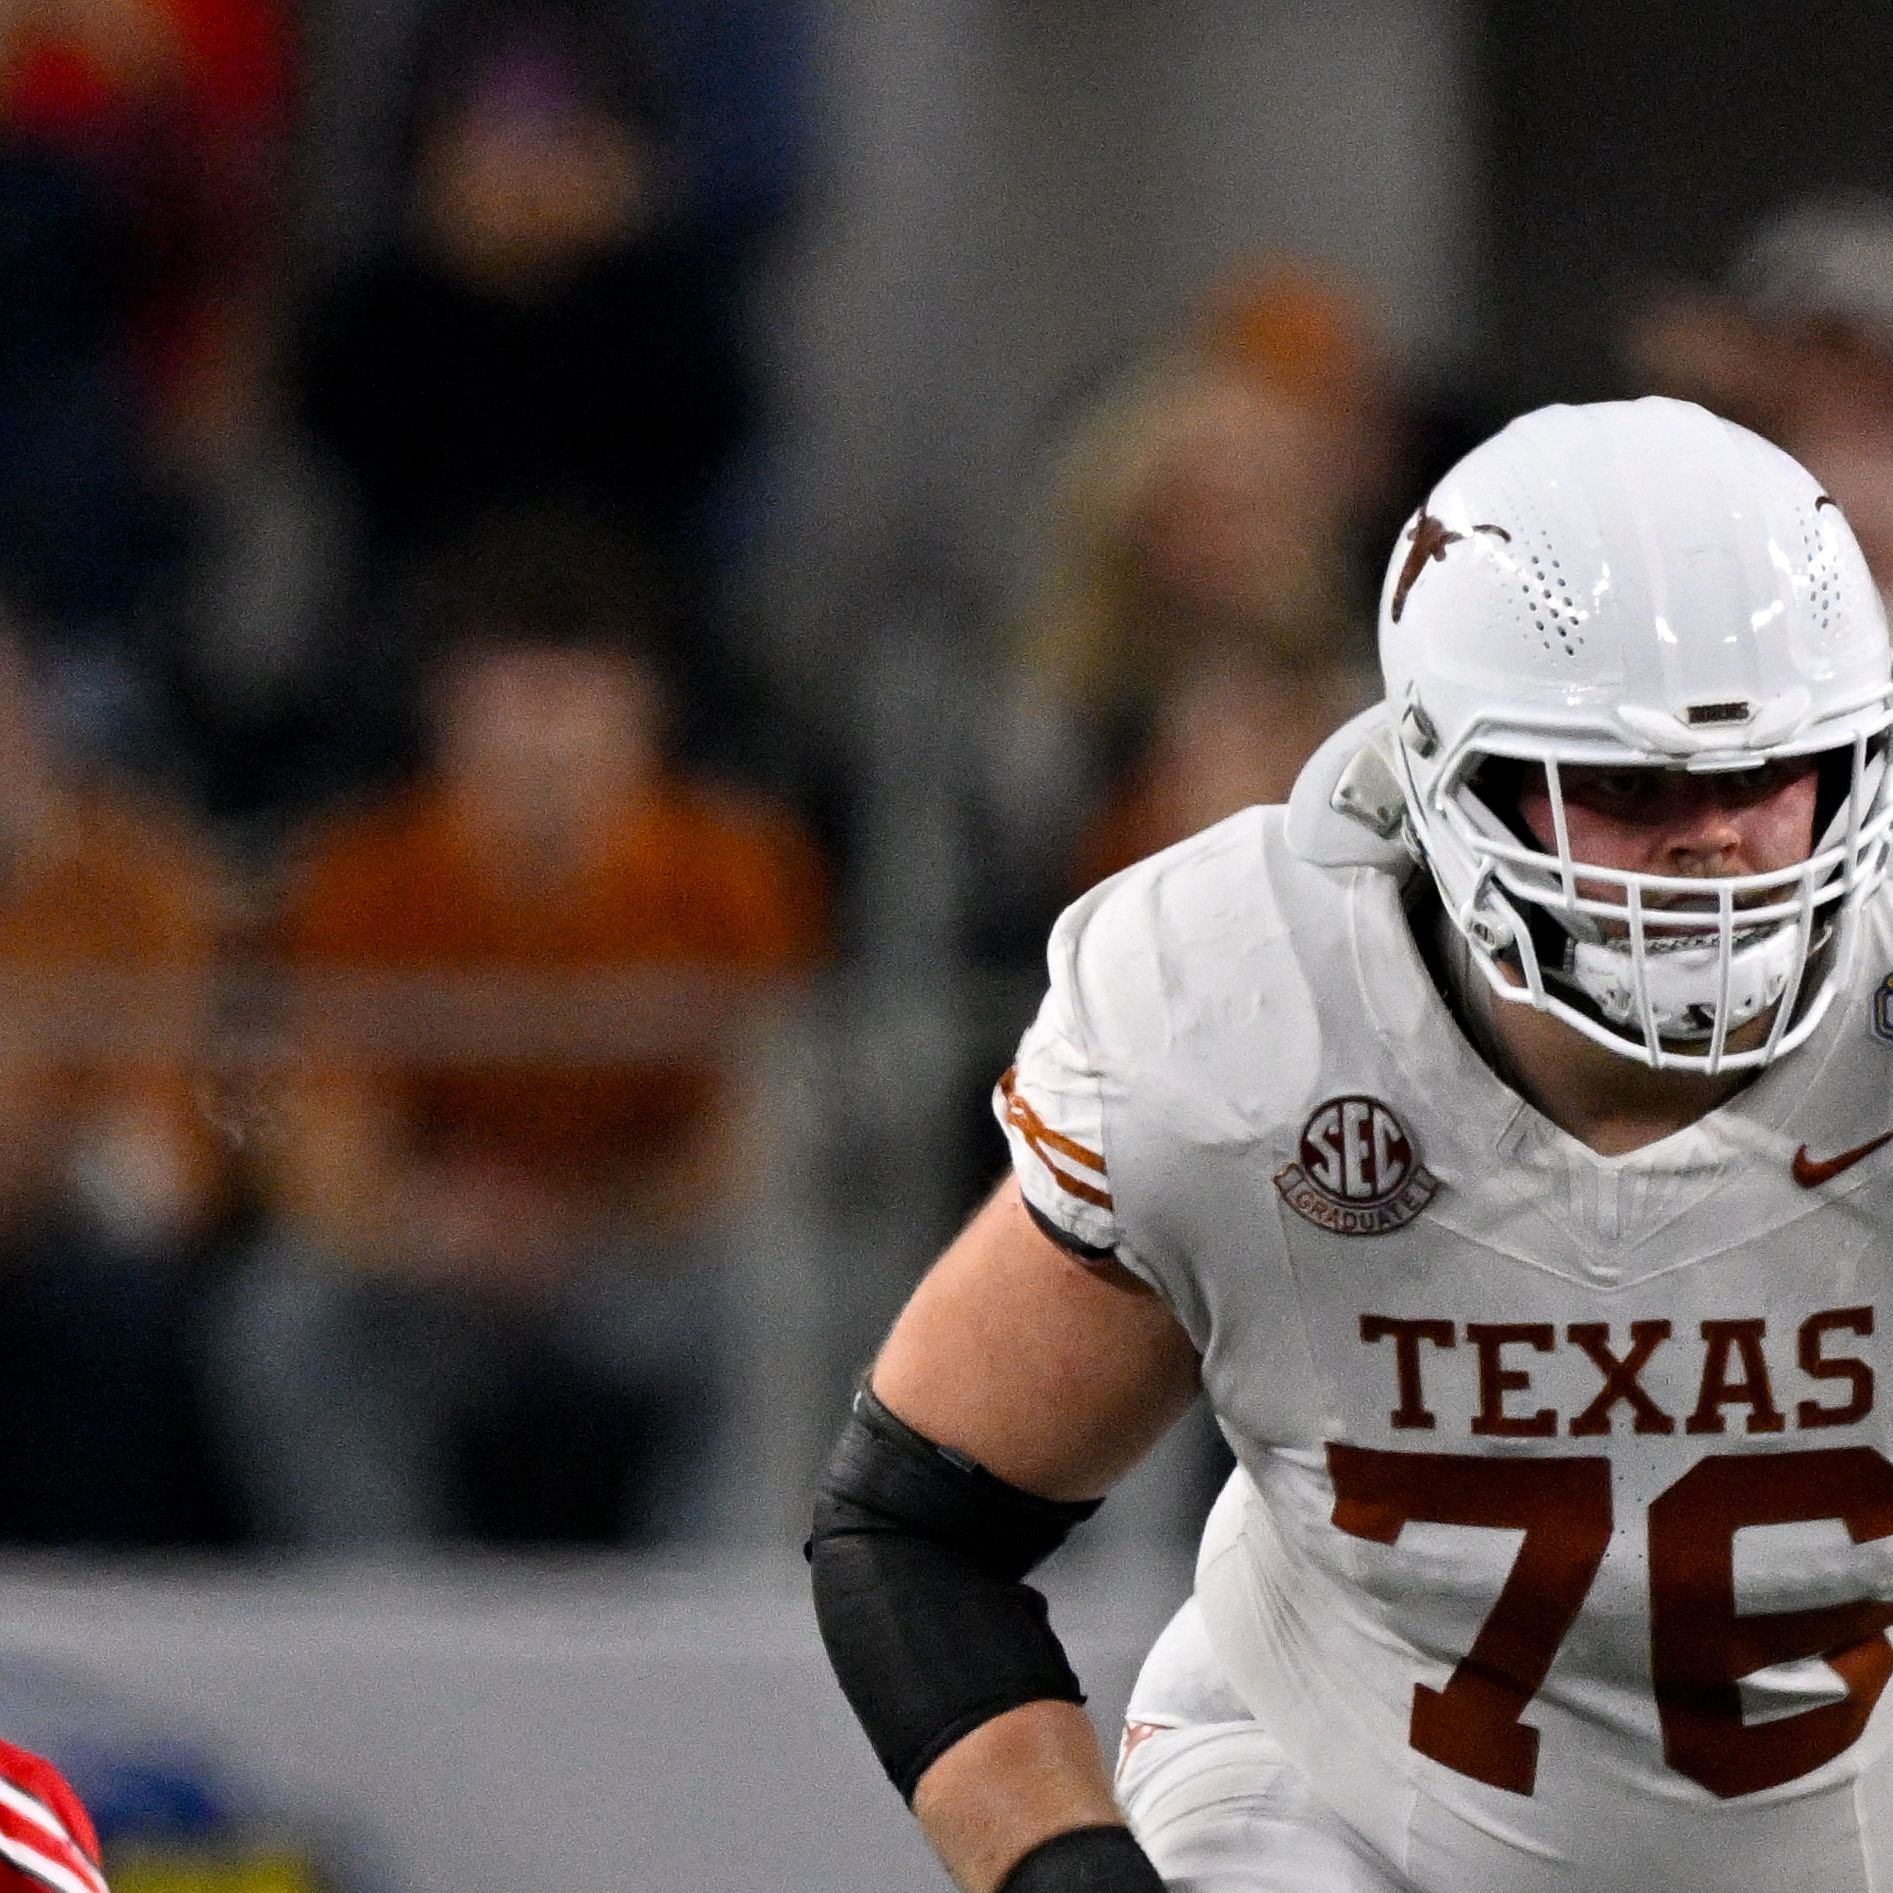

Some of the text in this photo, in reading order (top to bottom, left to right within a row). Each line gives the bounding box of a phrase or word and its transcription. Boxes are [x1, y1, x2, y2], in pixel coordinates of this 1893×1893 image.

[1306, 1101, 1405, 1197] SEC
[1295, 1189, 1419, 1231] GRADUATE
[1359, 1306, 1875, 1439] TEXAS
